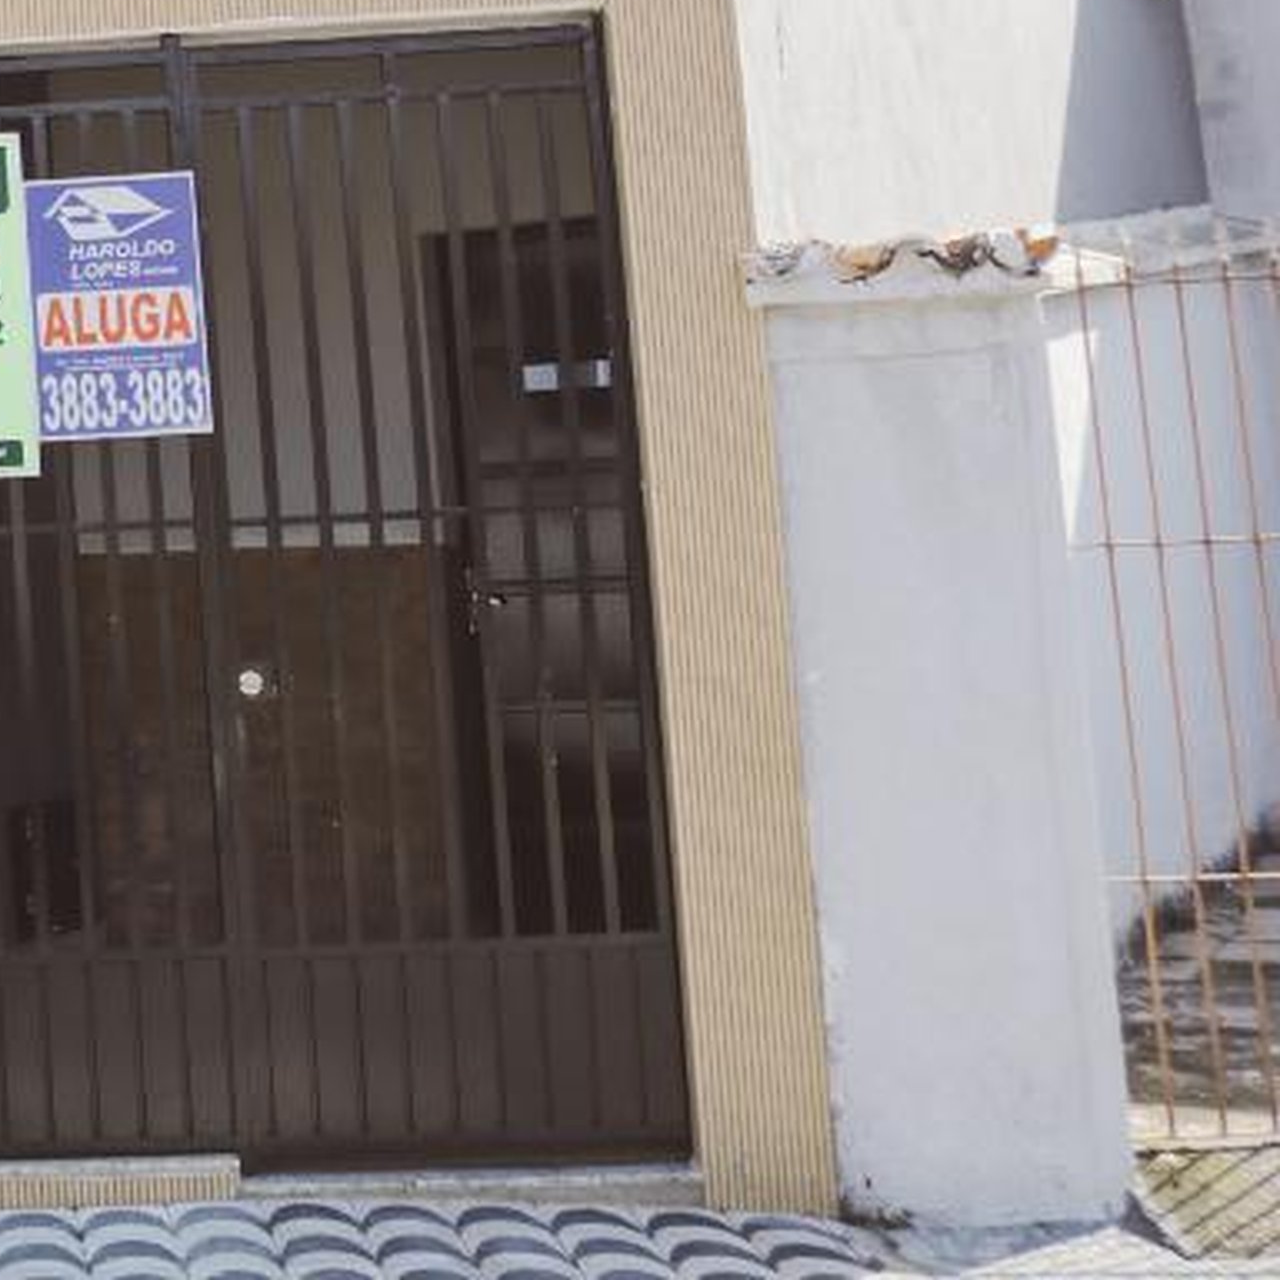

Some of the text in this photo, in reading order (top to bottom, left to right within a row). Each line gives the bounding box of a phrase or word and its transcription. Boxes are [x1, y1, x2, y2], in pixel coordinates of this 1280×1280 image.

[69, 239, 176, 261] HAROLDO
[71, 261, 141, 281] LOPES
[43, 291, 193, 347] ALUGA
[42, 369, 204, 431] 3883-3883
